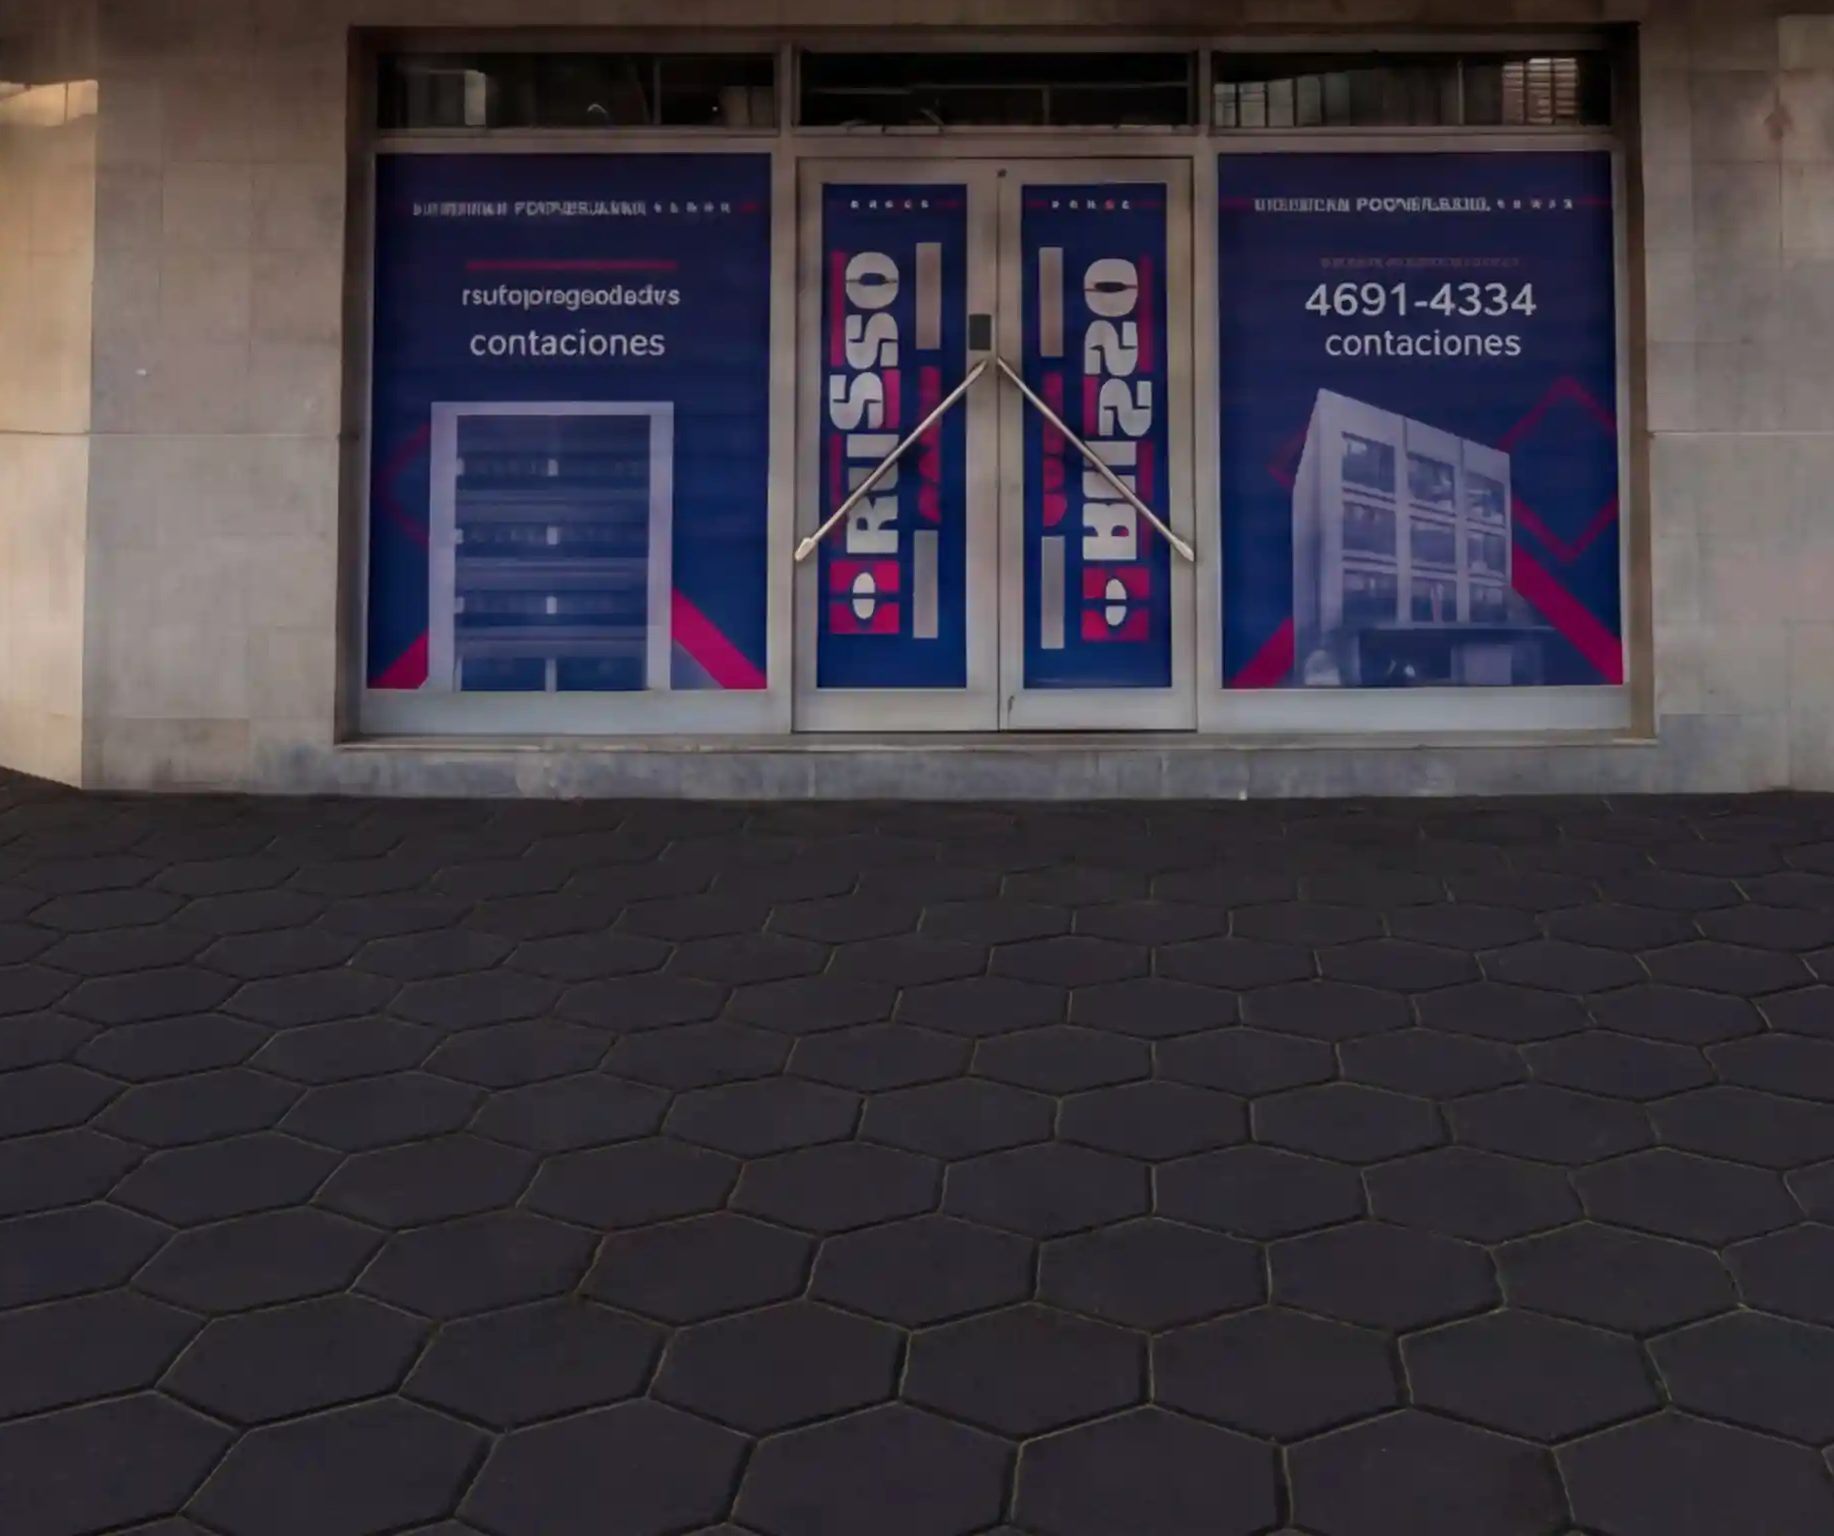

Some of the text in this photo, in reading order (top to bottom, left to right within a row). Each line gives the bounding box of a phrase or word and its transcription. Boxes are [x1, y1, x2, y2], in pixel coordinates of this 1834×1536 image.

[1304, 282, 1537, 317] 4691-4334
[469, 328, 666, 356] contaciones
[1324, 329, 1522, 357] contaciones
